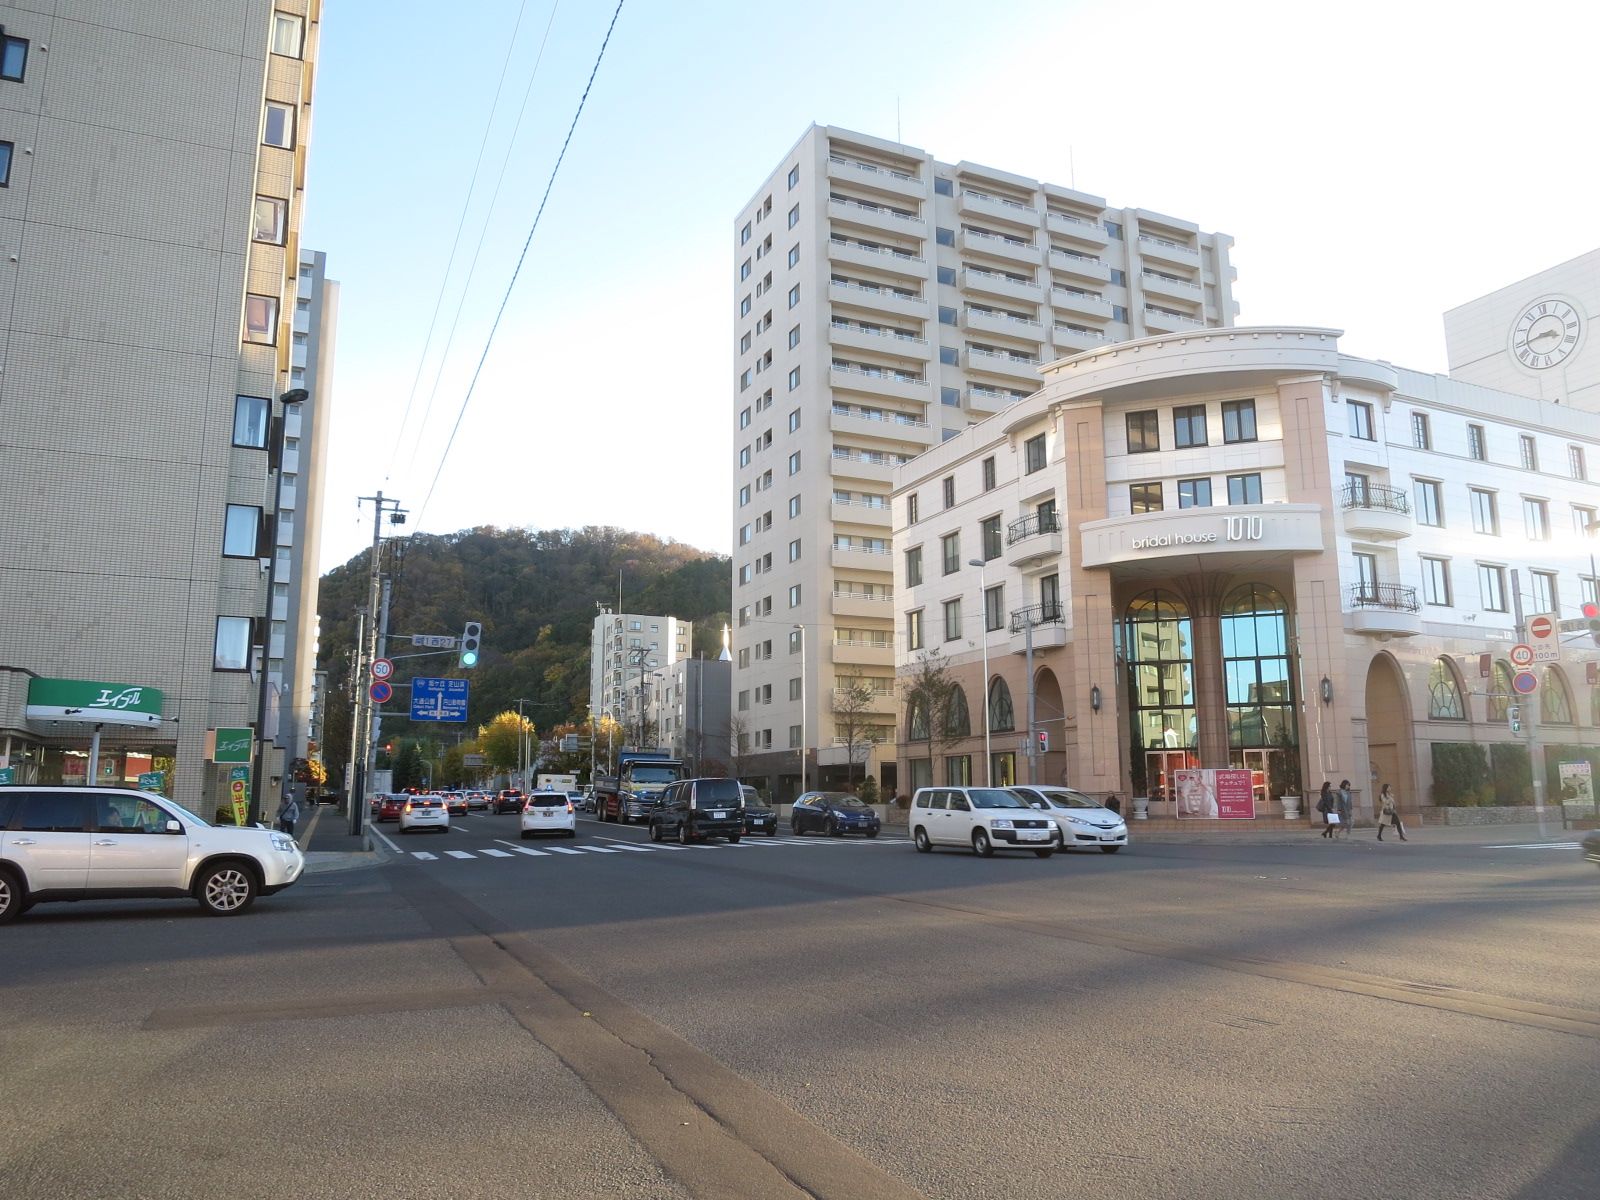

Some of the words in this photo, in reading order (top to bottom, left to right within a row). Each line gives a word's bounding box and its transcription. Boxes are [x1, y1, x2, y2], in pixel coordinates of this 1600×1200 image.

[1132, 533, 1172, 549] bridal
[1175, 531, 1217, 545] house
[1516, 651, 1529, 660] 40
[376, 664, 388, 674] 50
[88, 688, 143, 709] エイブル
